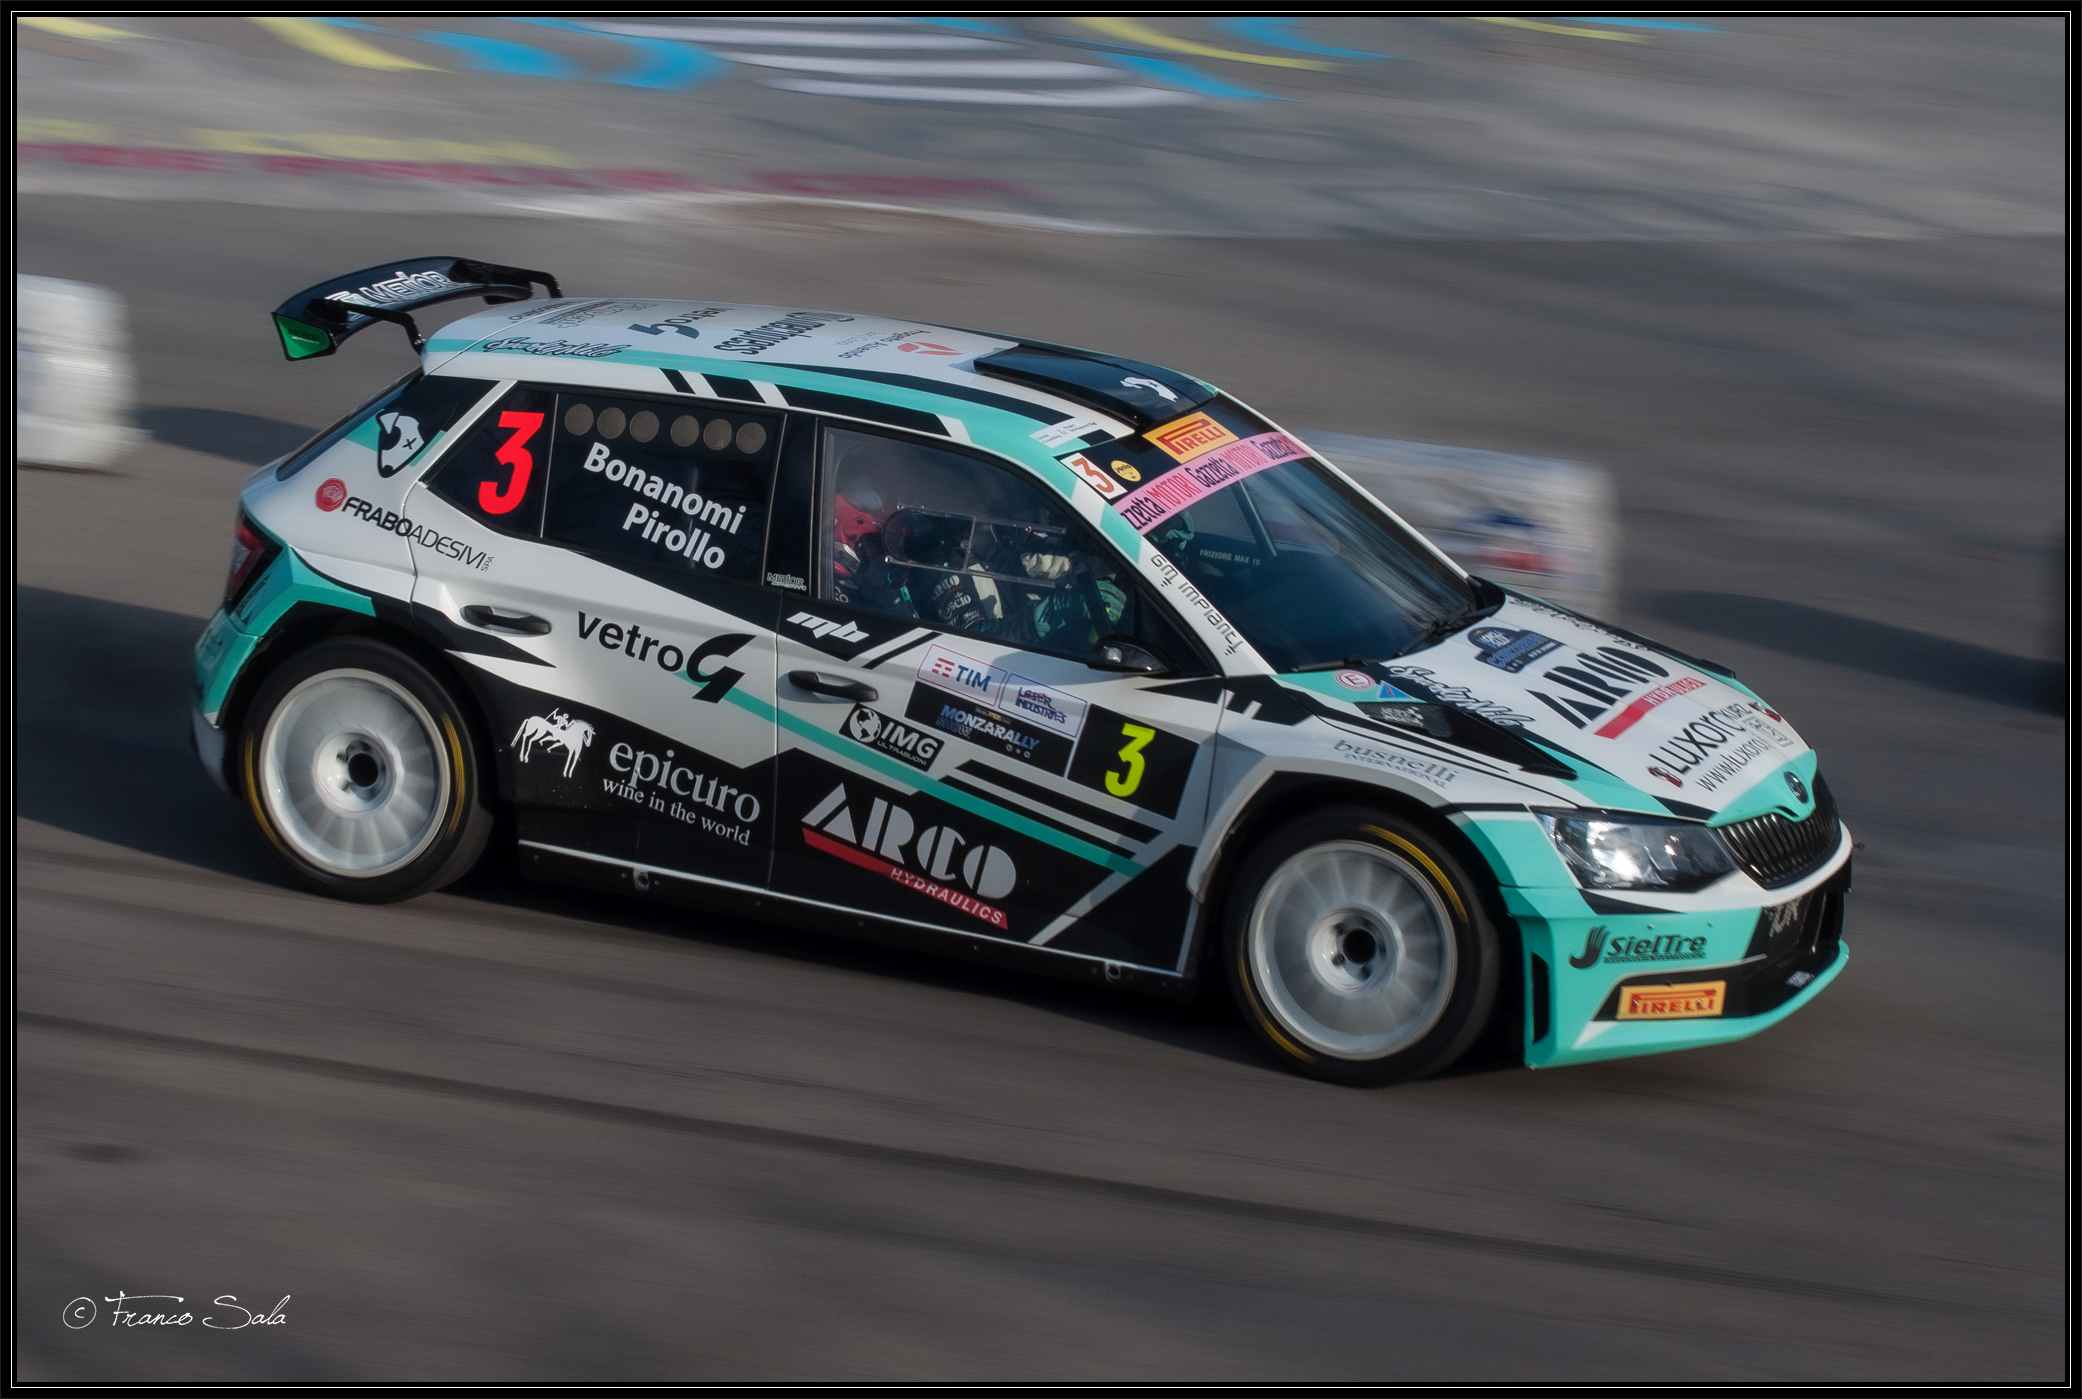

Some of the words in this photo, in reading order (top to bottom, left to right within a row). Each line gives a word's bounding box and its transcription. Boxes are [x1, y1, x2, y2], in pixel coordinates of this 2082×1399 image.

[1156, 419, 1226, 455] PIRELLI
[478, 411, 545, 515] 3
[583, 442, 747, 535] Bonanomi
[1072, 456, 1115, 493] 3
[1146, 472, 1203, 511] MOTORI
[1183, 456, 1240, 488] Gazzetta
[341, 496, 488, 569] FRABOADESIVI
[622, 502, 726, 569] Pirollo
[1199, 549, 1232, 561] FRIZIONE
[1234, 555, 1250, 564] MAX
[1252, 557, 1261, 566] 10
[578, 611, 758, 704] vetroG
[955, 665, 993, 692] TIM
[1015, 698, 1068, 725] INDUSTRIES
[1017, 686, 1056, 711] LASER
[881, 721, 939, 759] IMG
[940, 704, 1040, 751] MONZARALLY
[609, 742, 761, 822] epicuro
[1105, 722, 1156, 797] 3
[1333, 740, 1460, 783] busnelli
[602, 778, 645, 803] wine
[648, 791, 665, 813] in
[670, 802, 697, 824] the
[701, 815, 751, 846] world
[801, 782, 1017, 900] ARCO
[890, 867, 1004, 926] HYDRAULICS
[1605, 935, 1708, 956] SielTre
[1628, 988, 1717, 1015] PIRELLI
